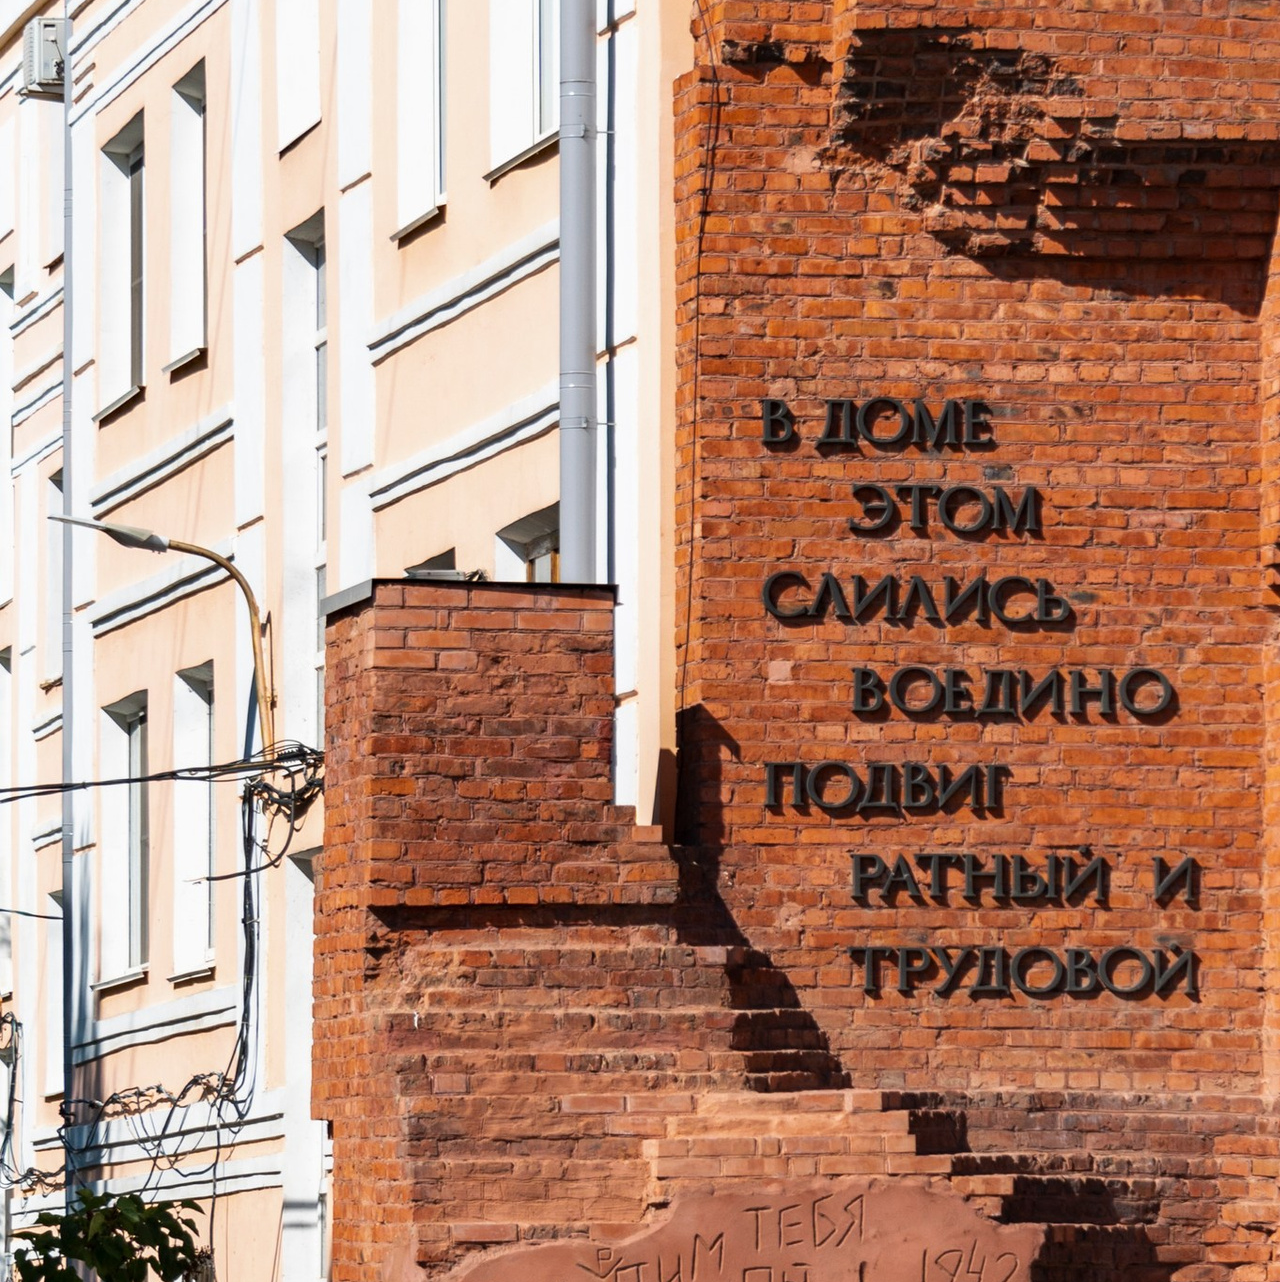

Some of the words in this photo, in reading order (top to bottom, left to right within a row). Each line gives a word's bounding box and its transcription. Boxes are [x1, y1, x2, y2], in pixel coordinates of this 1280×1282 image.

[761, 398, 797, 447] В
[816, 399, 996, 452] ДОМЕ
[849, 483, 1045, 537] ЭТОМ
[761, 571, 1073, 628] СЛИЛИСЬ
[851, 666, 1177, 720] ВОЕДИНО
[764, 761, 1012, 814] ПОДВИГ
[850, 847, 1107, 905] РАТНЫЙ
[1153, 856, 1200, 906] И
[848, 943, 1200, 998] ТРУДОВОЙ
[742, 1193, 865, 1254] ТЕБЯ
